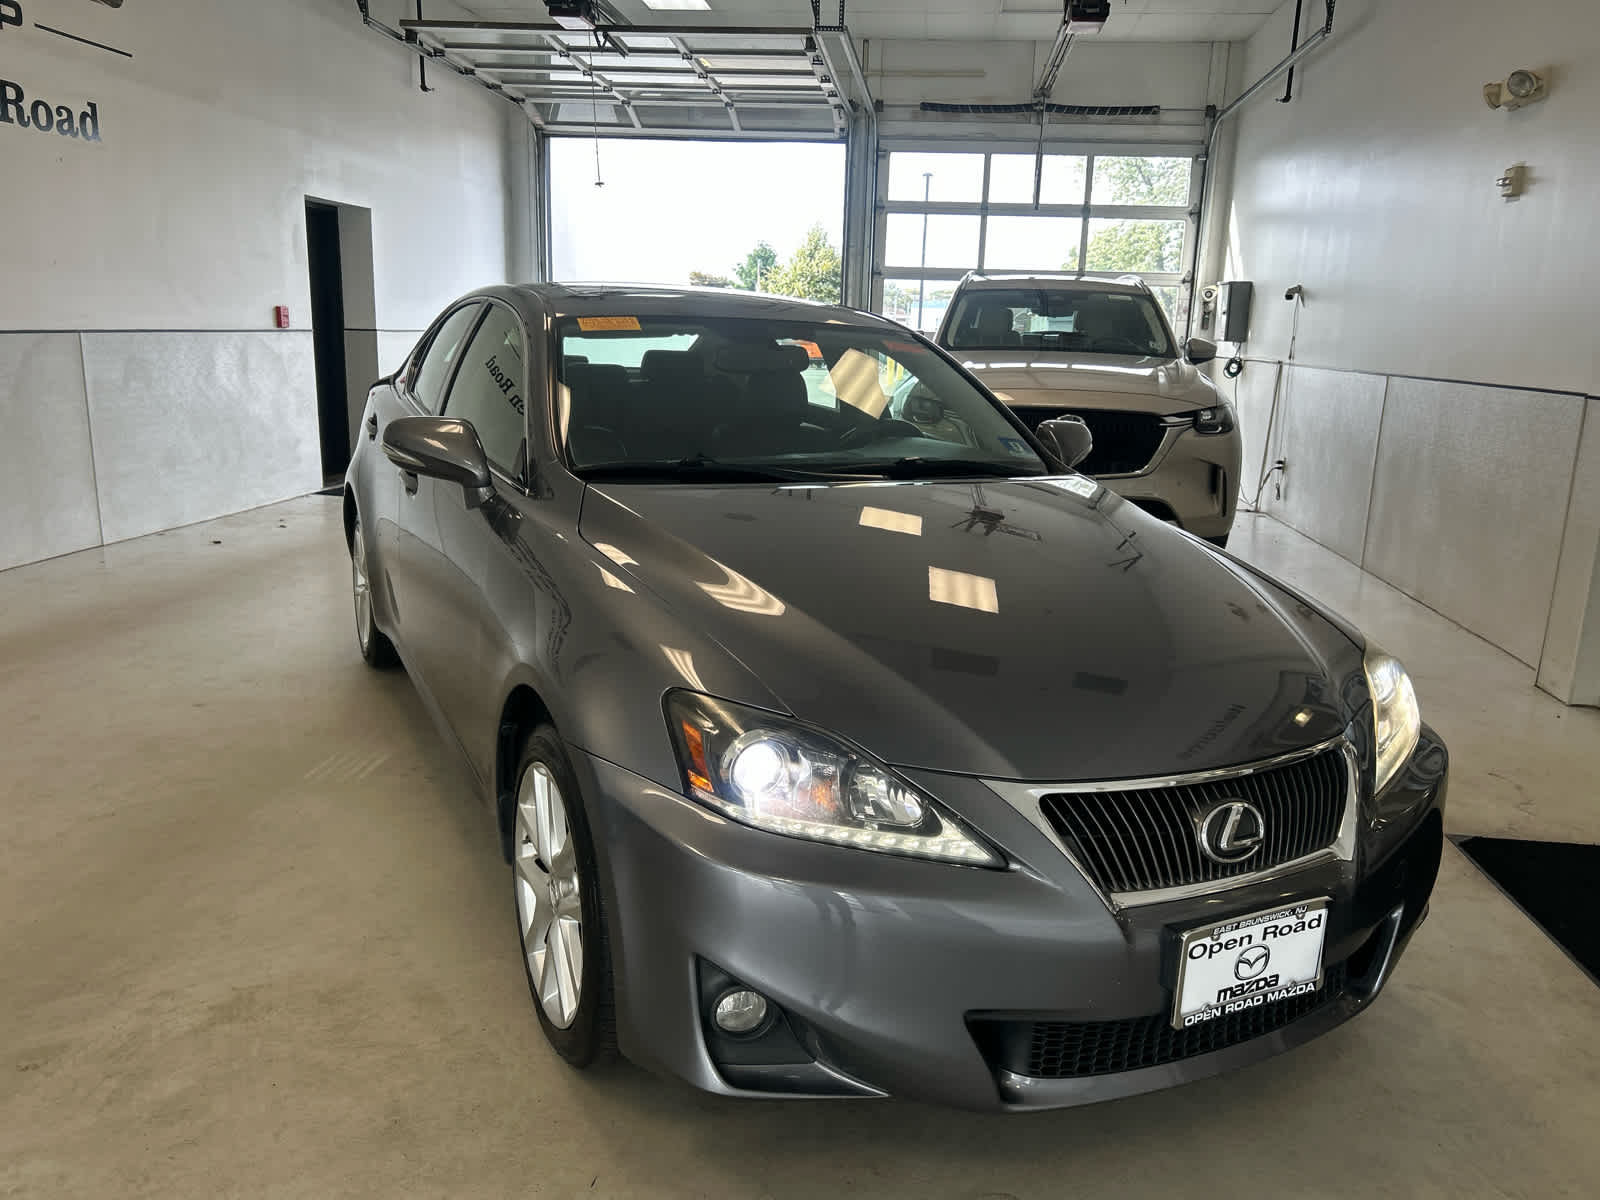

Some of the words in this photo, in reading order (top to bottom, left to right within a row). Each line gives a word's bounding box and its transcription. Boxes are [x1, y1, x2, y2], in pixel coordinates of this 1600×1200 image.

[0, 79, 102, 142] Road
[1188, 934, 1253, 960] Open
[1262, 914, 1322, 941] Road
[1213, 923, 1237, 935] EAST
[1295, 905, 1308, 915] NJ
[1184, 1007, 1221, 1026] OPEN
[1225, 995, 1263, 1014] ROAD
[1267, 982, 1315, 1003] MAZDA
